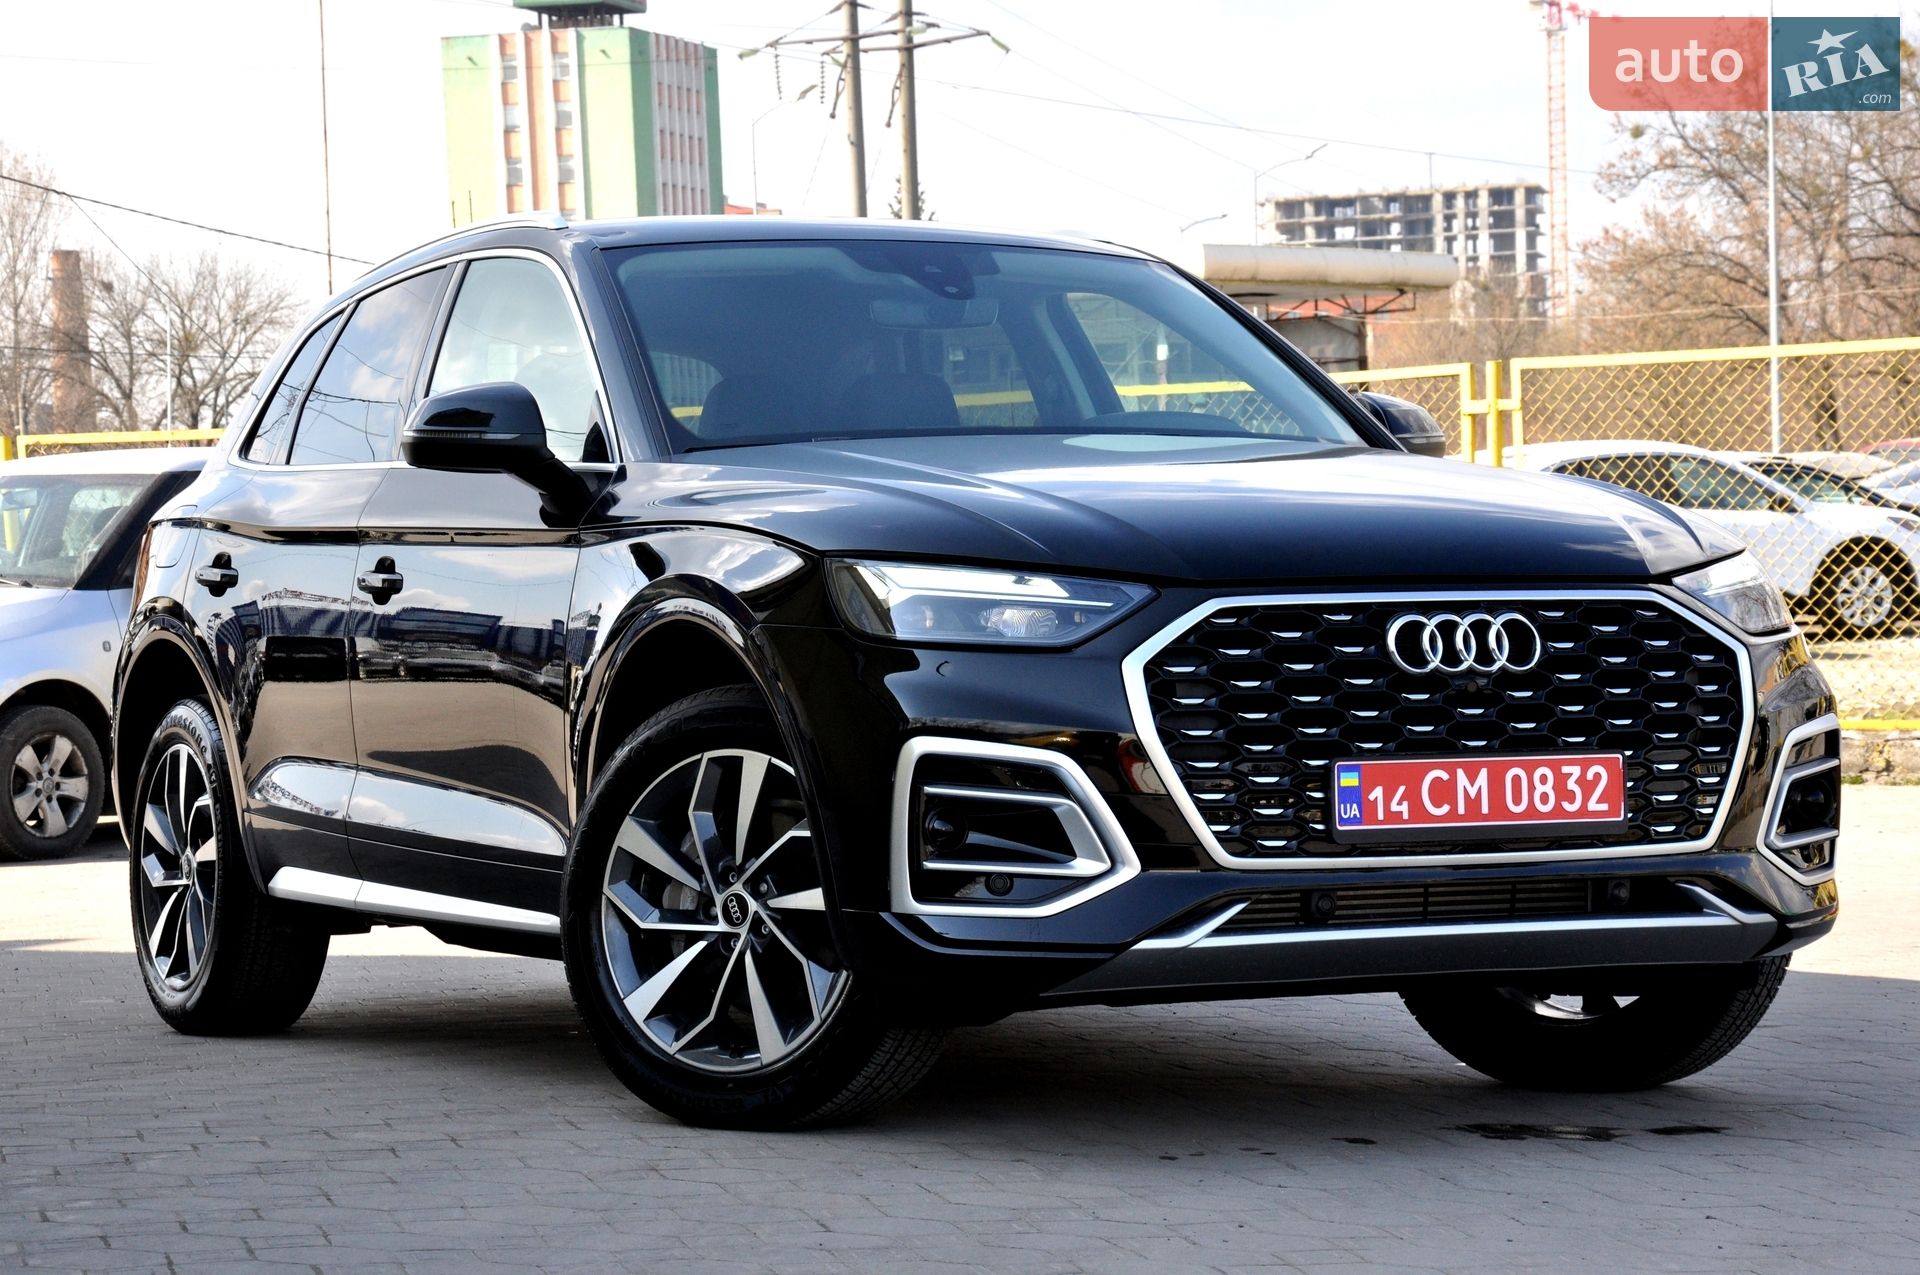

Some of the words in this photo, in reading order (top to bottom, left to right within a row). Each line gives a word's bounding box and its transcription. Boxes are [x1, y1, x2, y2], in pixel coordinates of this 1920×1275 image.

[1340, 803, 1360, 819] UA
[1368, 785, 1409, 820] 14
[1421, 768, 1488, 816] CM
[1505, 764, 1609, 814] 0832
